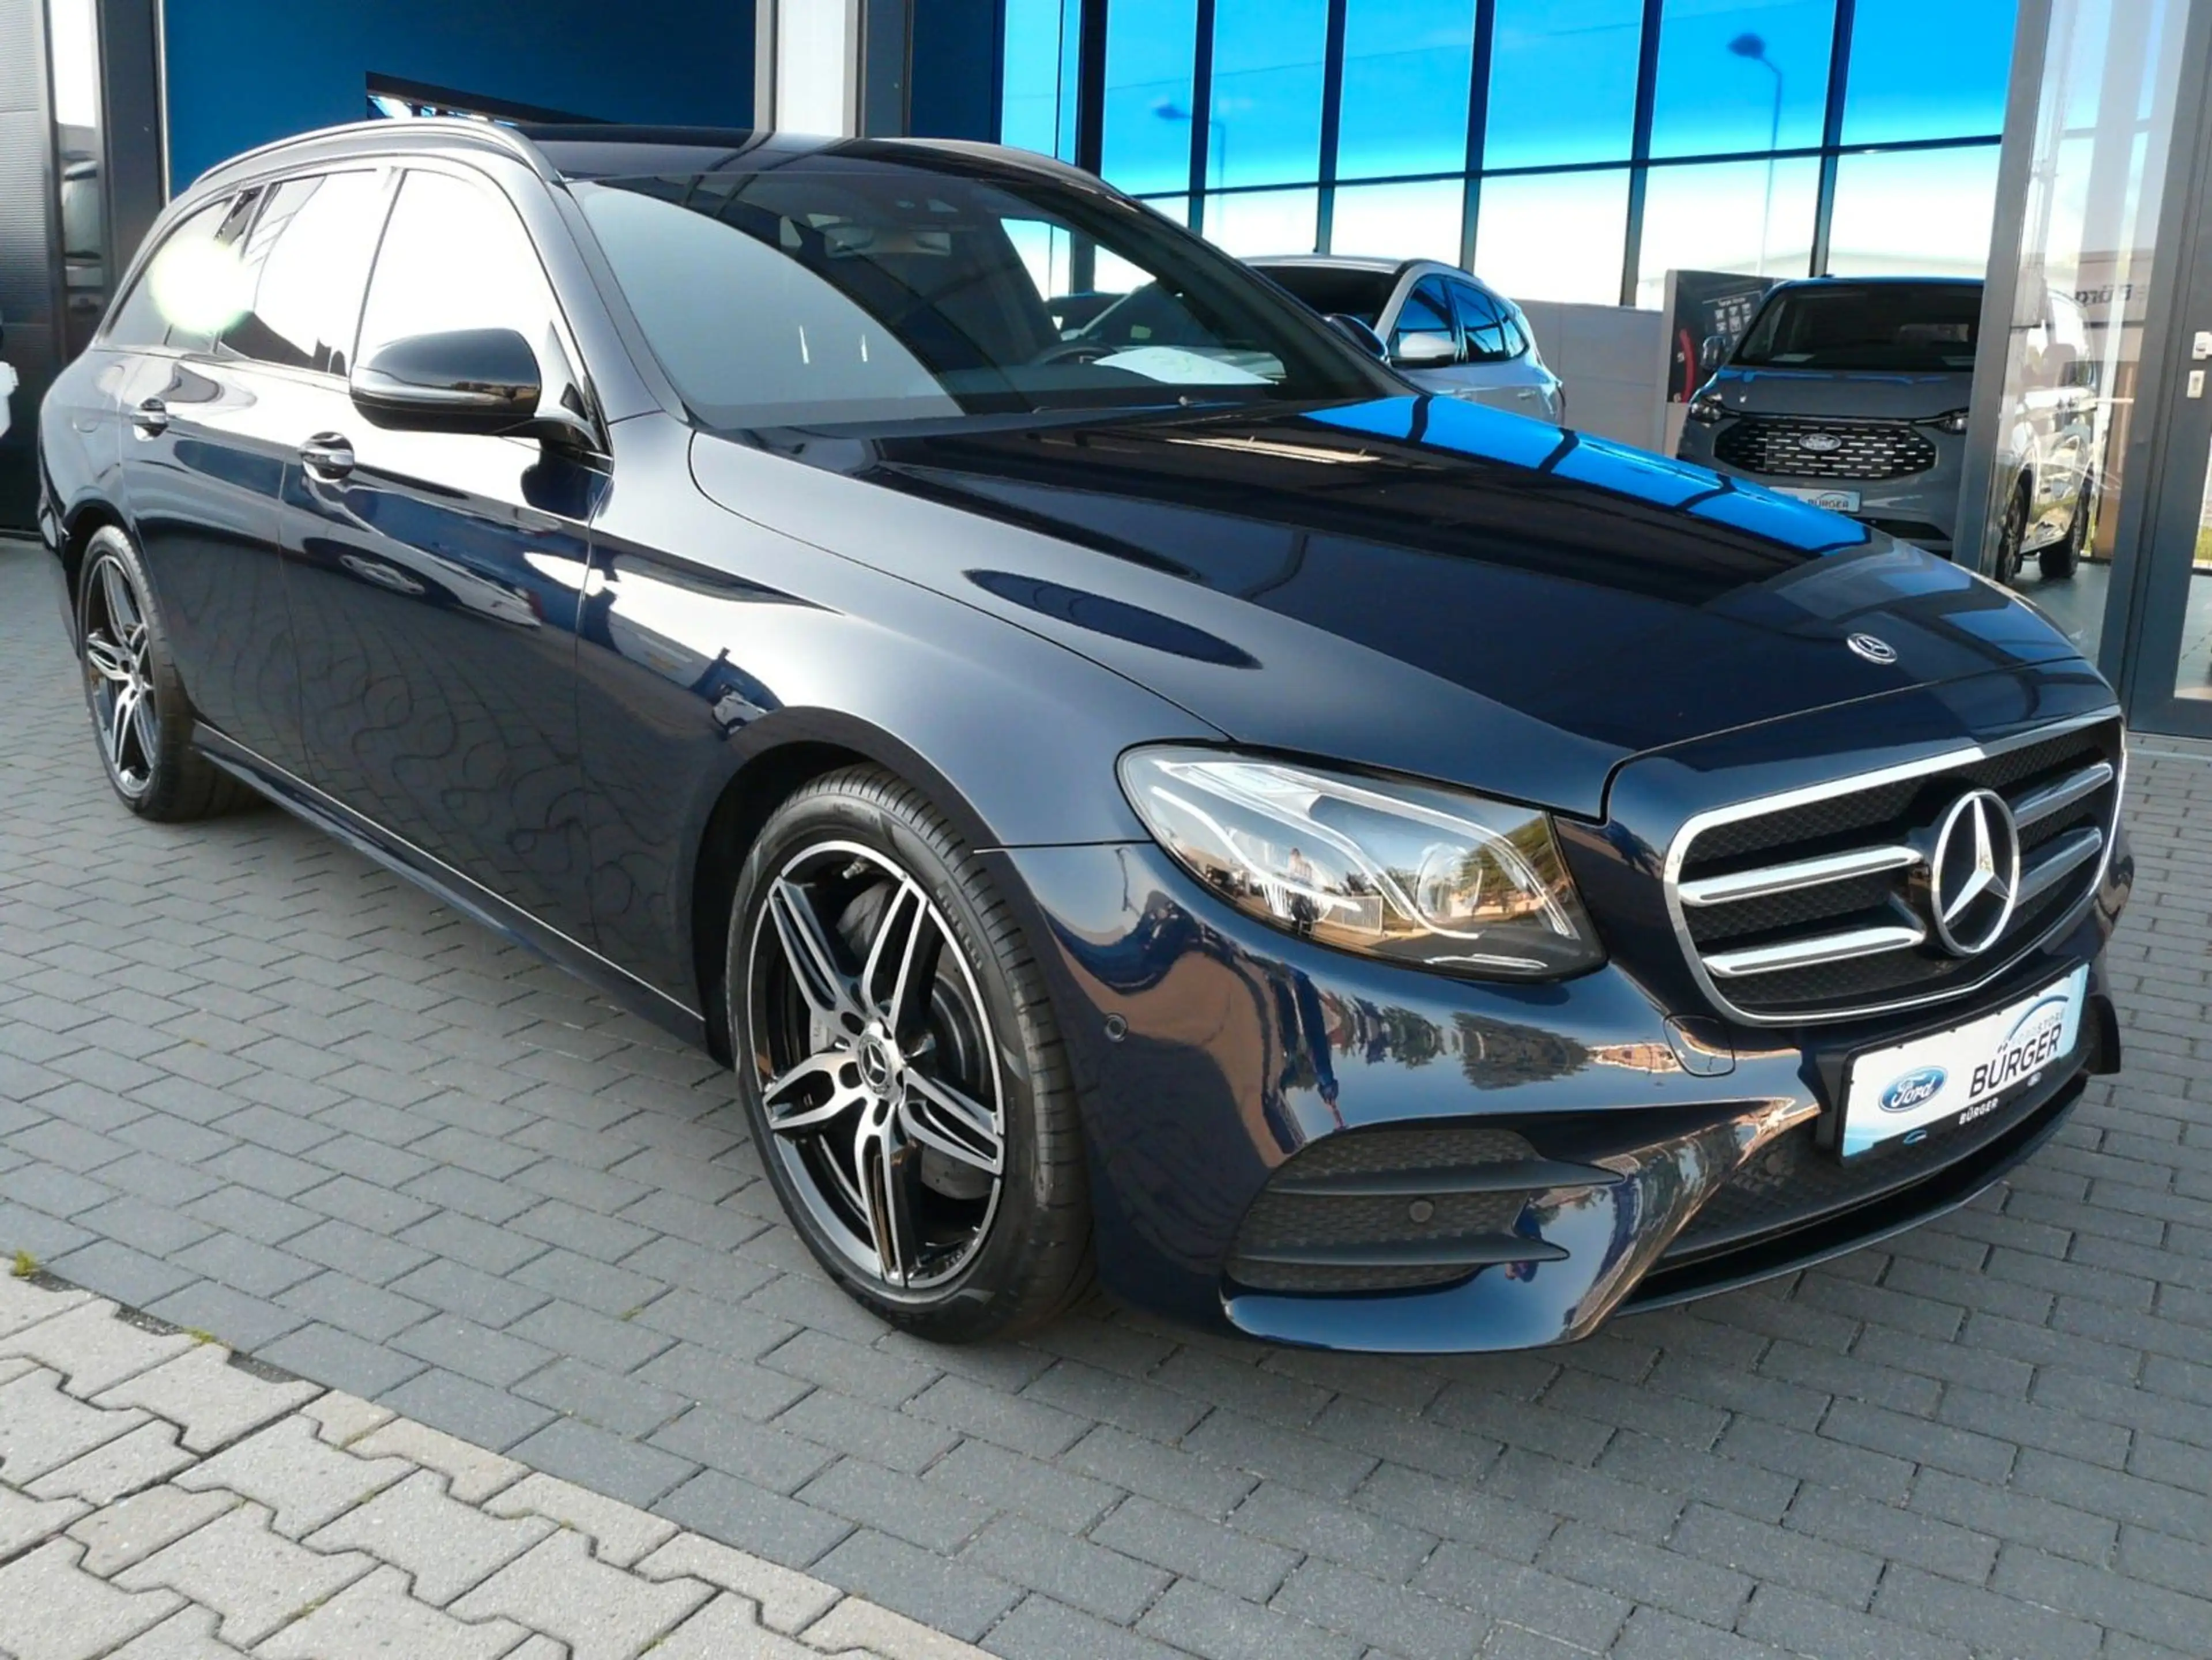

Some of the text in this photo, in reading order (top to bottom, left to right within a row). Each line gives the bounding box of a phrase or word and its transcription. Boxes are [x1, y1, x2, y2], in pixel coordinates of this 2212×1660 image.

[1969, 1023, 2062, 1099] BÜRGER
[1891, 1075, 1937, 1107] Ford
[1958, 1097, 1999, 1125] BÜRGER
